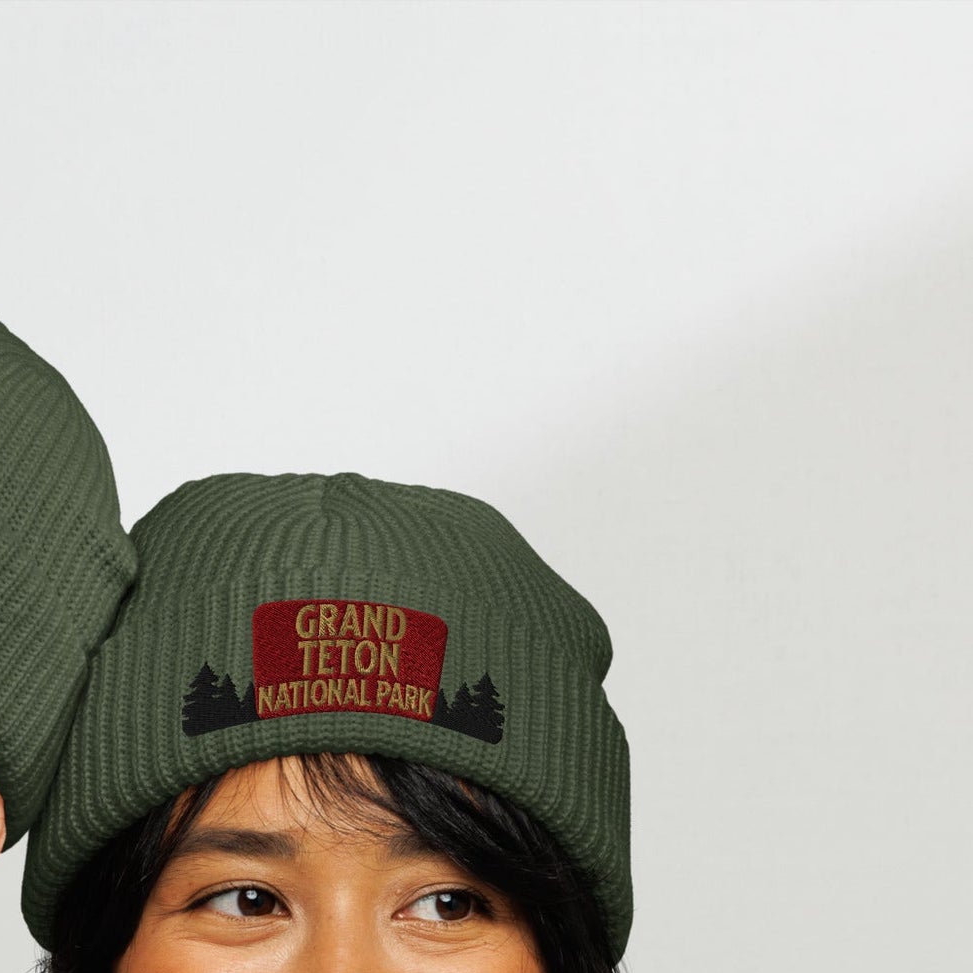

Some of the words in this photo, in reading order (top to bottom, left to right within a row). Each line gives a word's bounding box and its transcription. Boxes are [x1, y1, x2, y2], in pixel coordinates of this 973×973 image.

[295, 604, 406, 641] GRAND
[298, 640, 401, 678] TETON
[258, 679, 371, 714] NATIONAL
[377, 680, 435, 717] PARK
